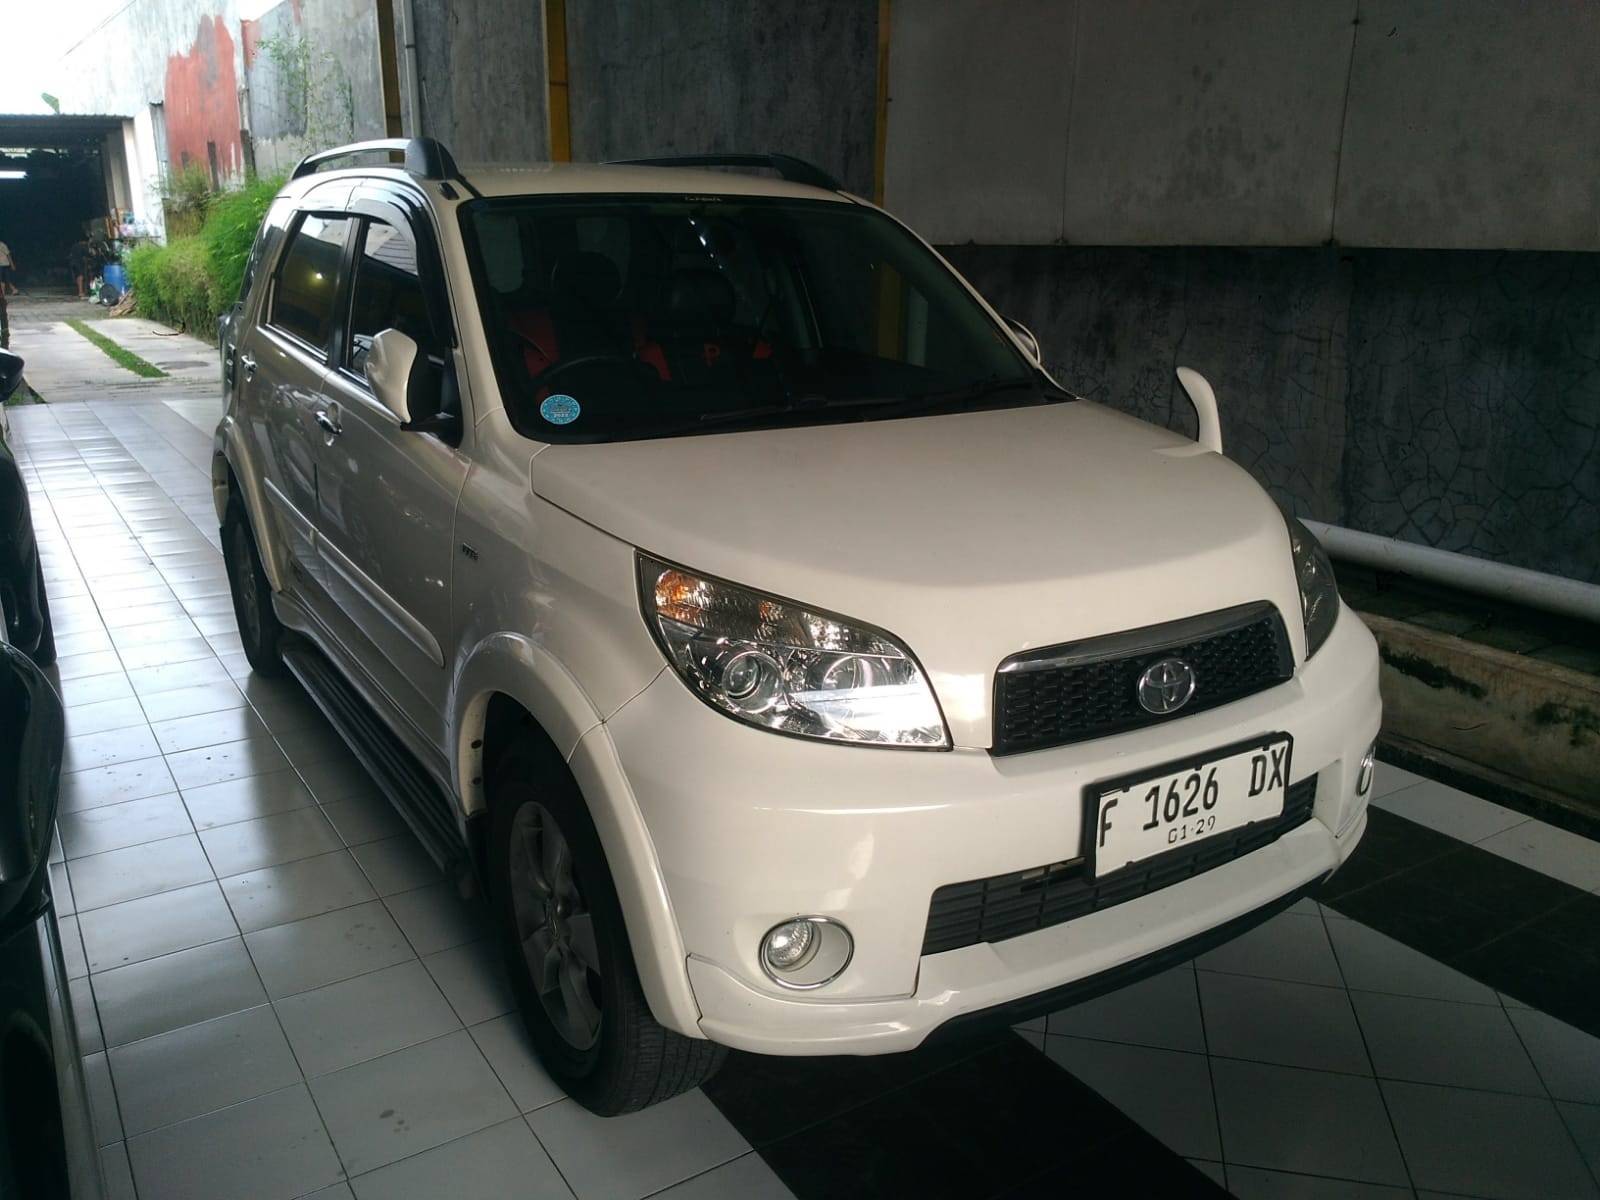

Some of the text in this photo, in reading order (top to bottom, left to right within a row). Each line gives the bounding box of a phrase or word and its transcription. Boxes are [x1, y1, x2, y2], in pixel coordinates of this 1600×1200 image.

[1100, 746, 1286, 847] F 1626 DX
